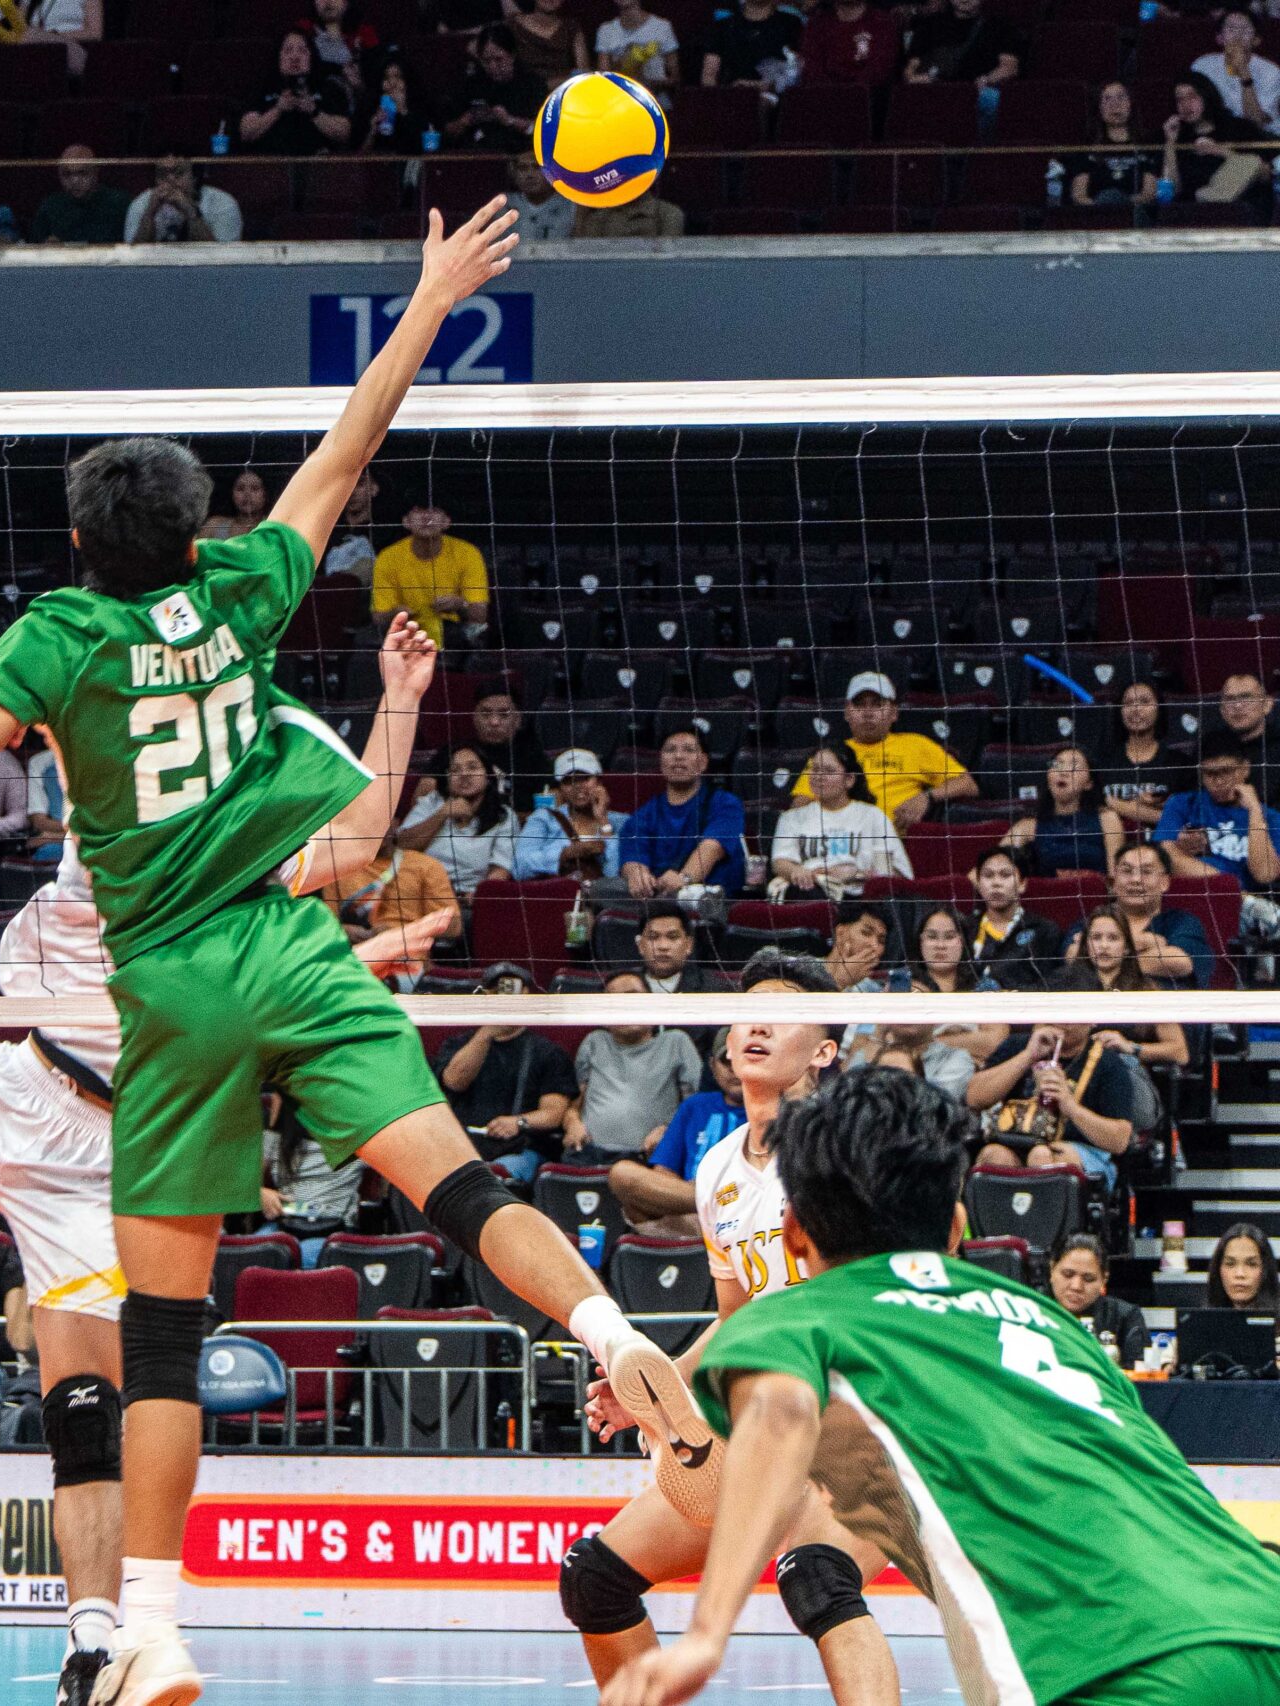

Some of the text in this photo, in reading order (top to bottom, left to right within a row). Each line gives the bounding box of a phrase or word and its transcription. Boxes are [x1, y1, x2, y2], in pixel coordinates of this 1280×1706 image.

[128, 673, 258, 824] 20
[218, 1519, 347, 1561] MEN'S
[365, 1520, 394, 1562] &
[30, 1583, 65, 1602] HER
